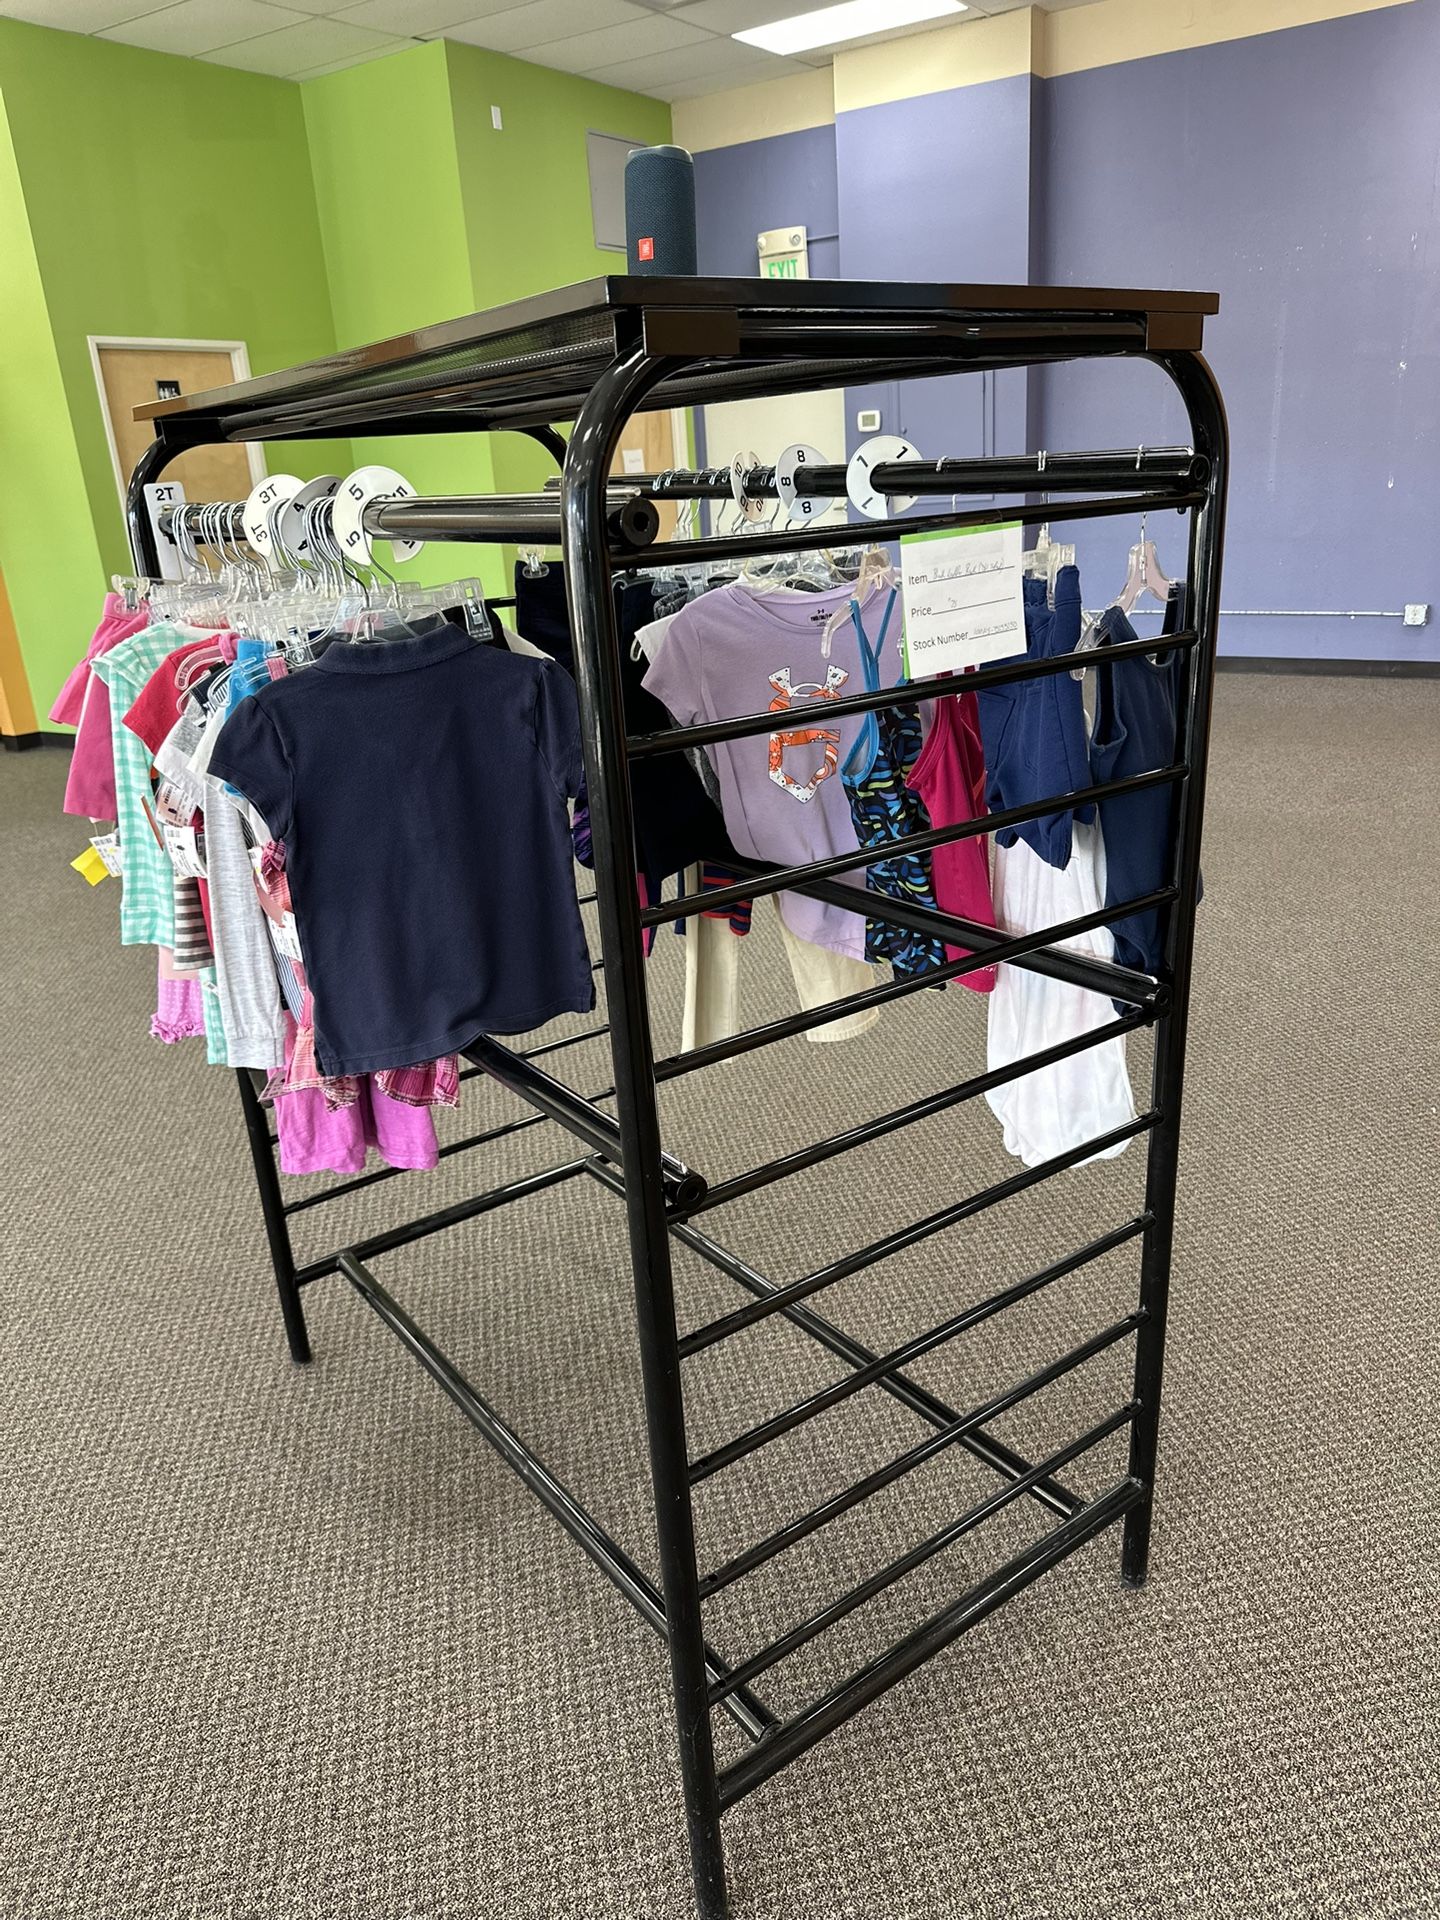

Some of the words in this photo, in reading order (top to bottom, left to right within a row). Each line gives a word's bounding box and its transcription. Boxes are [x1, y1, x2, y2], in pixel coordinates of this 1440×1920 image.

[797, 450, 806, 463] 8
[896, 446, 909, 460] 1
[857, 454, 869, 468] 1
[734, 462, 742, 477] 10
[781, 476, 791, 486] 8
[155, 487, 174, 501] 2T
[259, 484, 278, 504] 3T
[326, 482, 337, 496] 4
[348, 483, 364, 501] 5
[293, 502, 305, 513] 4
[802, 501, 812, 514] 8
[861, 497, 873, 509] 1
[251, 523, 268, 543] 3T
[346, 531, 361, 547] 5
[908, 574, 928, 585] Item
[911, 606, 932, 618] Price
[913, 637, 936, 651] Stock
[937, 631, 969, 645] Number
